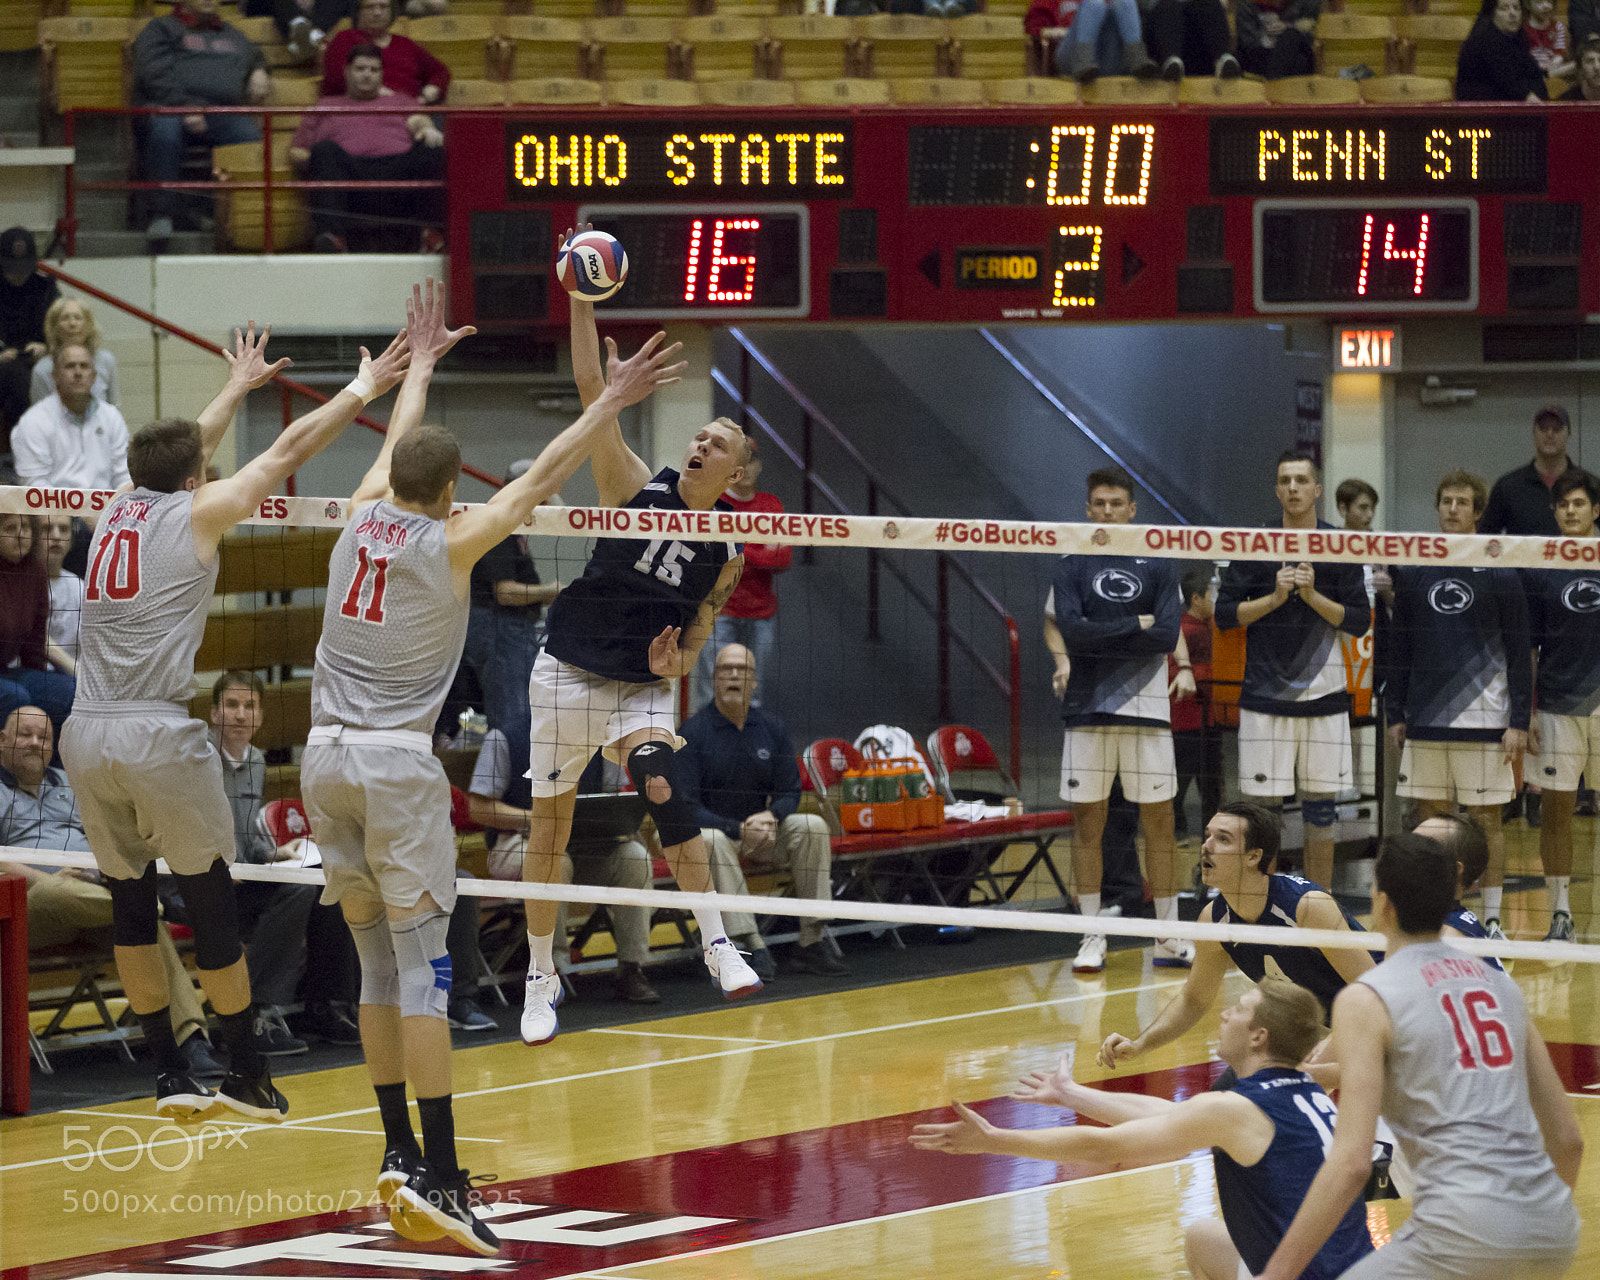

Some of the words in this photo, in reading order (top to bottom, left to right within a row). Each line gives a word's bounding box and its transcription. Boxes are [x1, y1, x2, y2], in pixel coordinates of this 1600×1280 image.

[514, 134, 628, 187] OHIO
[665, 133, 845, 186] STATE
[1258, 129, 1386, 182] PENN
[1424, 128, 1492, 180] ST
[588, 253, 601, 280] NCAA
[684, 219, 761, 302] 16
[962, 255, 1038, 280] PERIOD
[1052, 224, 1103, 307] 2
[1354, 211, 1432, 296] 14
[1341, 329, 1395, 368] EXIT
[25, 487, 85, 510] OHIO
[568, 508, 632, 532] OHIO
[638, 511, 711, 534] STATE
[717, 514, 851, 539] BUCKEYES
[936, 522, 1058, 547] #GoBucks
[1145, 528, 1214, 552] OHIO
[1220, 531, 1300, 554] STATE
[1308, 533, 1449, 560] BUCKEYES
[86, 528, 141, 601] 10
[633, 540, 697, 587] 15
[1543, 540, 1600, 563] #Go
[341, 546, 389, 623] 11
[1441, 990, 1514, 1070] 16
